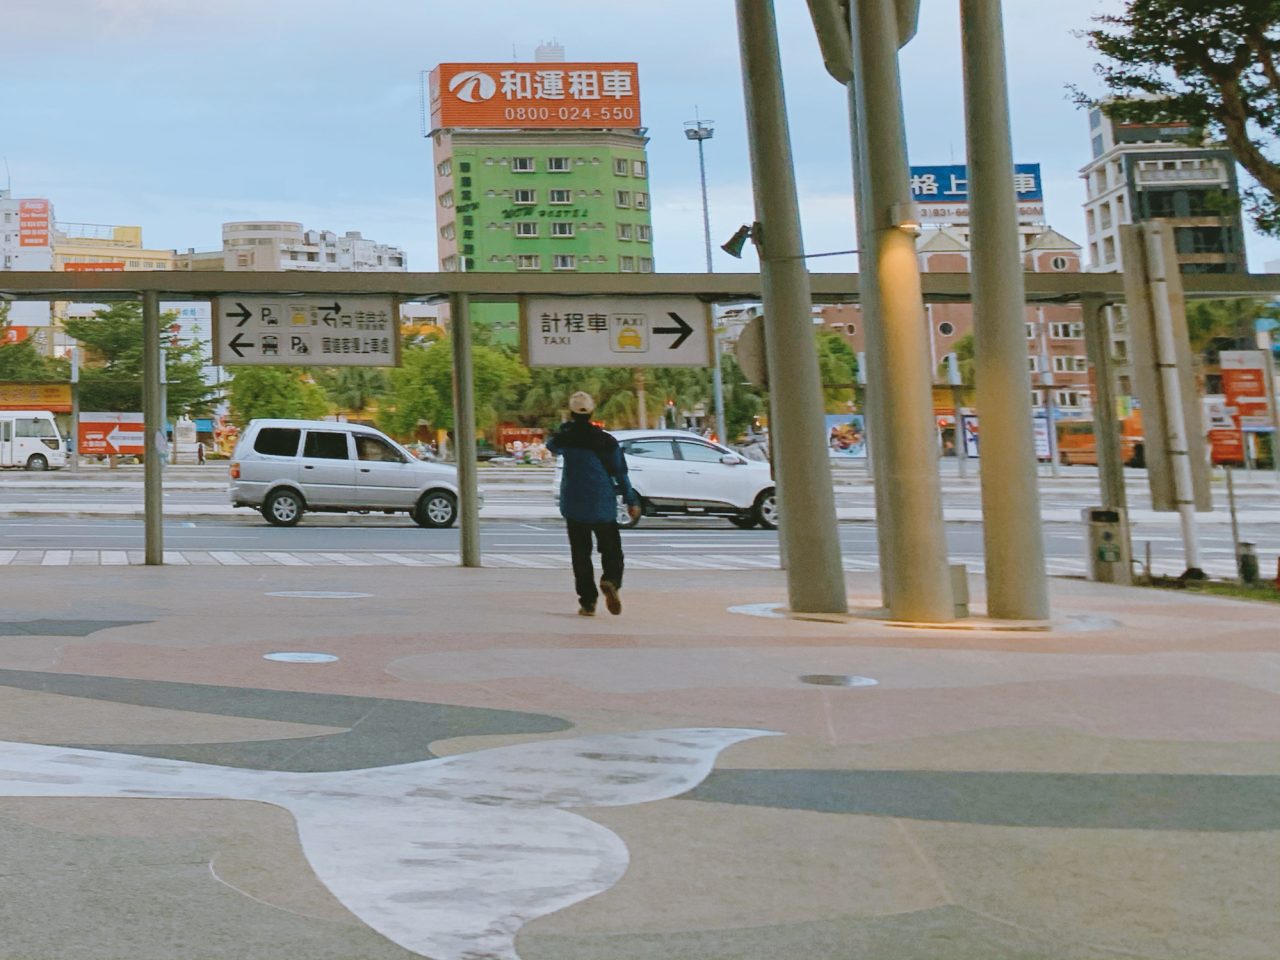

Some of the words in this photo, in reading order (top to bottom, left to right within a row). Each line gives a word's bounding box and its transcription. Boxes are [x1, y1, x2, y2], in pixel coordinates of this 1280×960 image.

[500, 70, 633, 100] 和運租車
[505, 107, 633, 120] 0800-024-550
[910, 172, 1037, 195] 格上車
[540, 312, 608, 334] 計程車
[615, 317, 644, 326] TAXI
[543, 336, 571, 345] TAXI
